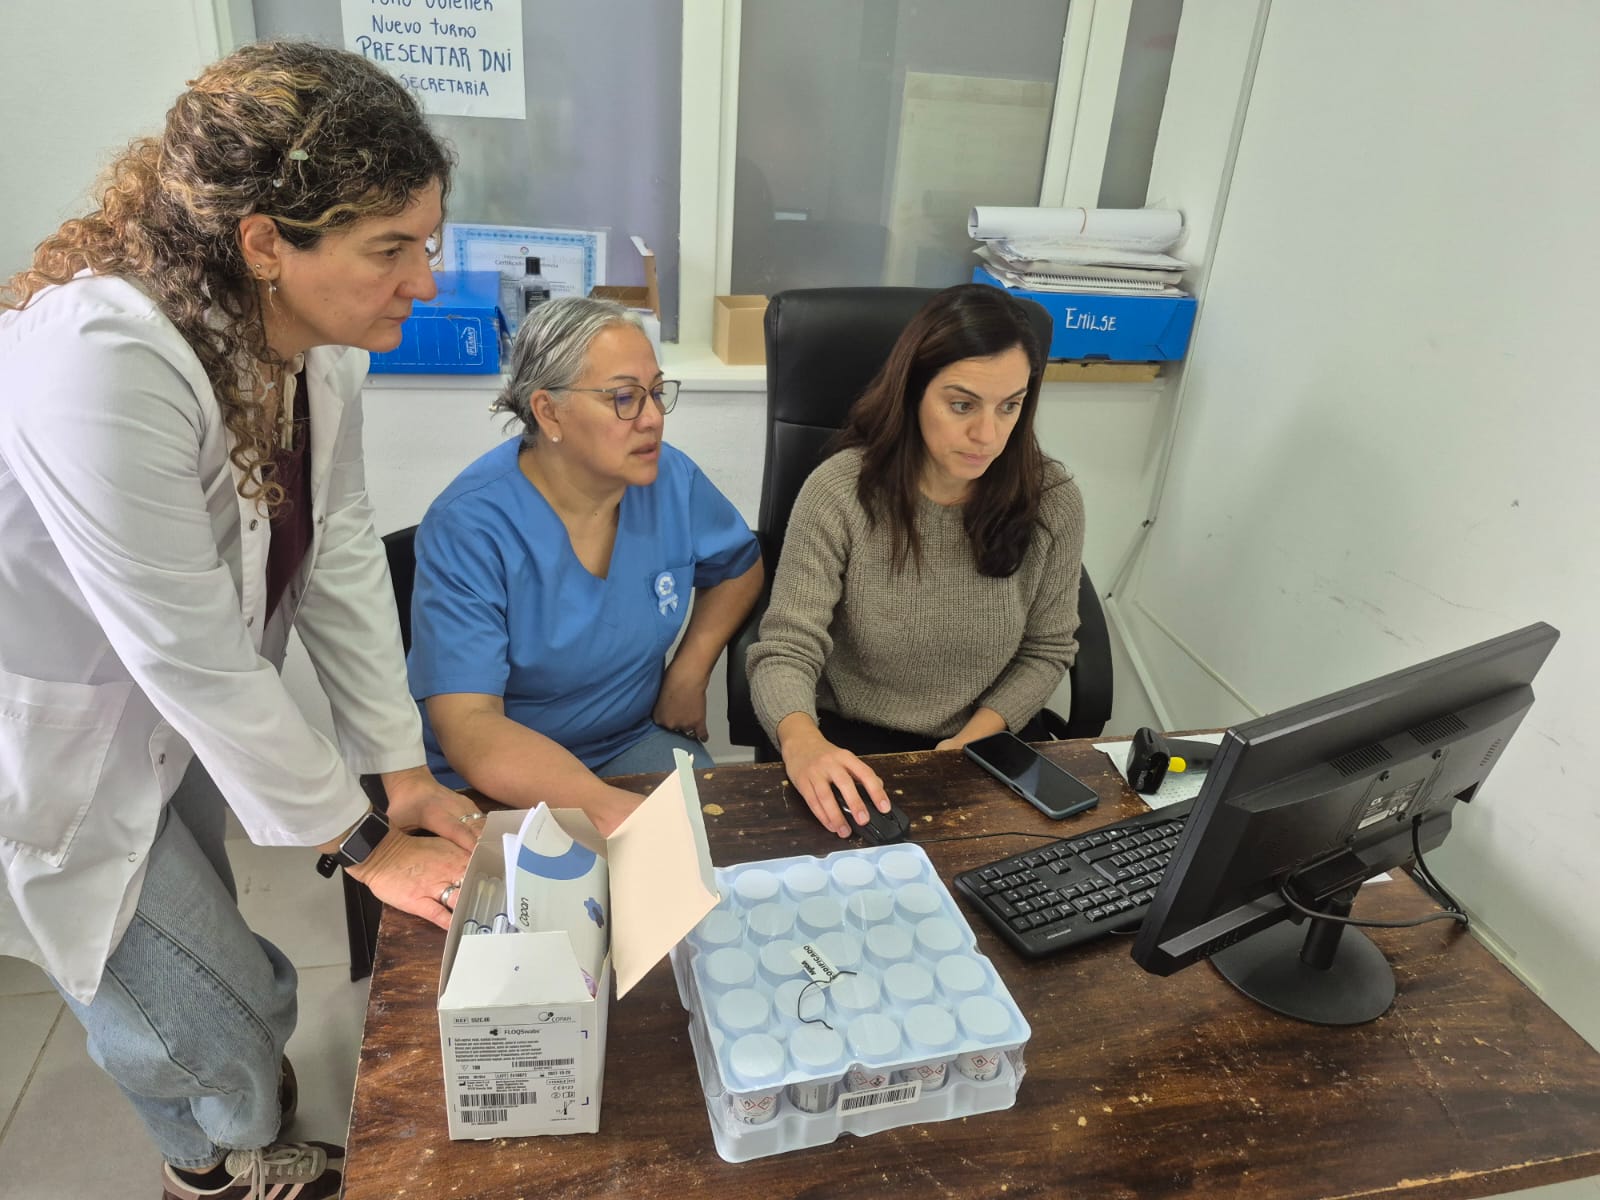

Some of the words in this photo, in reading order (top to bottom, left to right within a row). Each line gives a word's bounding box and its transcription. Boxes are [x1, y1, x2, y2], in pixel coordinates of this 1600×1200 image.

[372, 14, 422, 34] Nuevo
[355, 35, 472, 72] PRESENTAR
[802, 945, 836, 978] ODIFICADO
